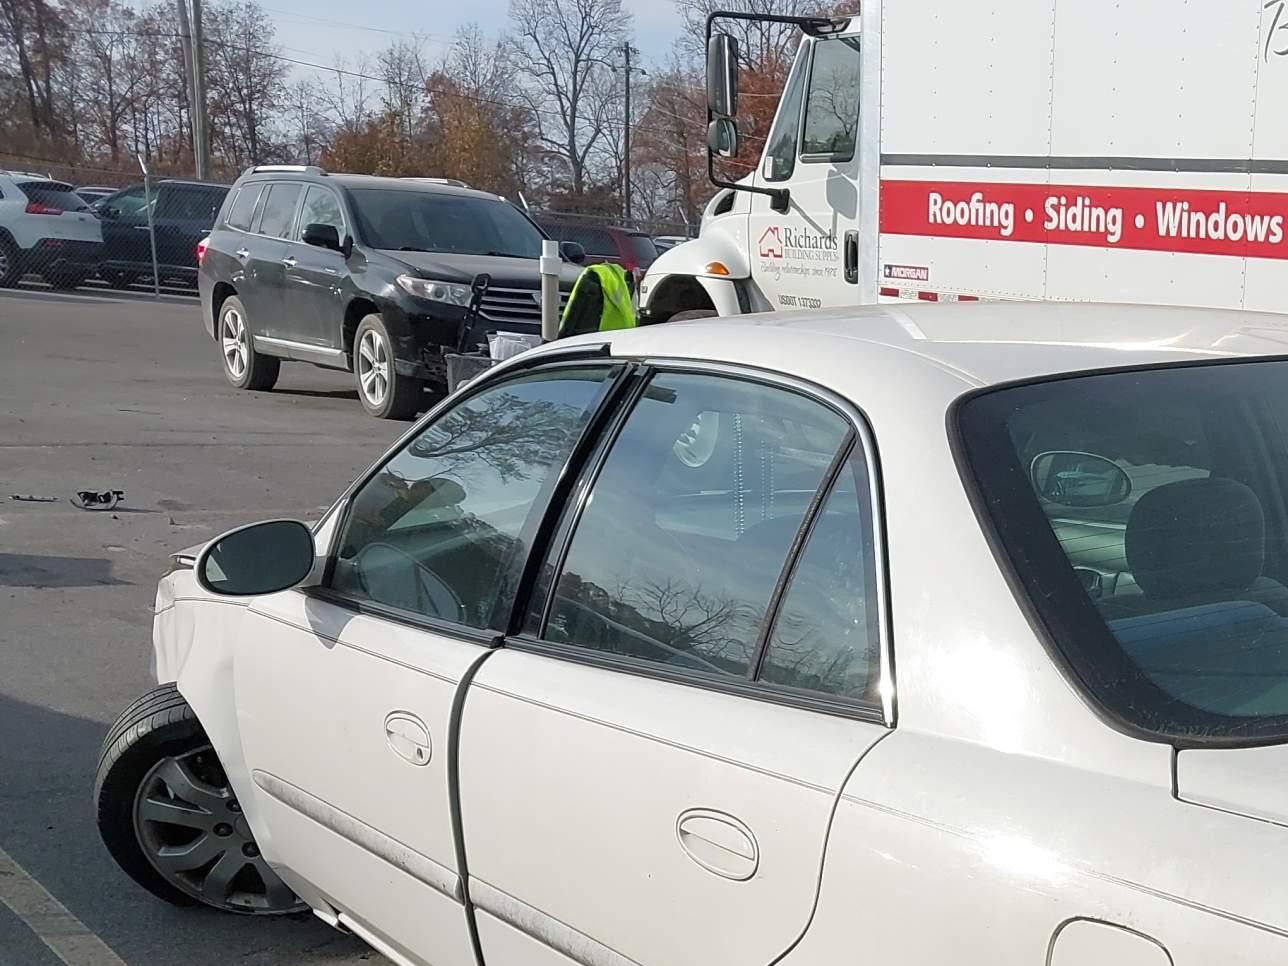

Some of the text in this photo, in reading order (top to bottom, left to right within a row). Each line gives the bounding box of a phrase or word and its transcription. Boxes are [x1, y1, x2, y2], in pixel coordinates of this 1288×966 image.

[928, 192, 1015, 236] Roofing
[1043, 195, 1123, 243] Siding
[1155, 200, 1284, 243] Windows
[784, 227, 838, 250] Richards
[890, 267, 928, 280] MORGAN
